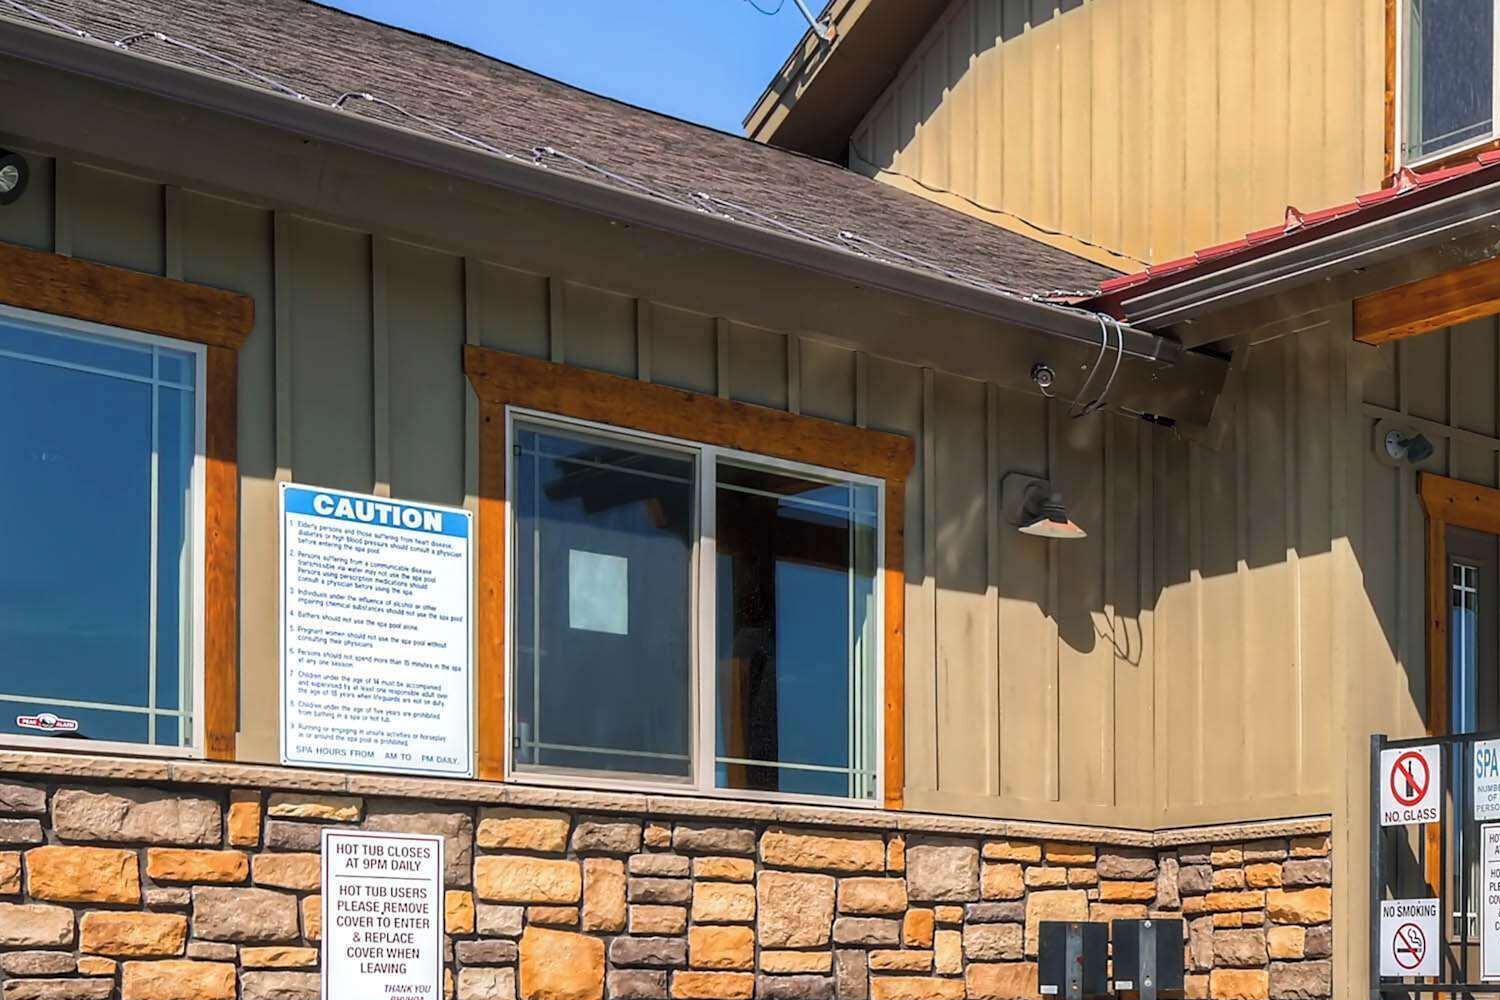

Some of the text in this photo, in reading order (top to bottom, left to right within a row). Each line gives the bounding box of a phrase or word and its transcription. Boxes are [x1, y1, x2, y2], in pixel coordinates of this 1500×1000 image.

[312, 493, 442, 532] CAUTION
[296, 744, 312, 753] SPA
[316, 746, 346, 756] HOURS
[350, 748, 374, 758] FROM
[384, 751, 397, 760] AM
[400, 753, 411, 761] TO
[421, 754, 433, 763] PM
[1476, 748, 1499, 779] SPA
[1488, 794, 1497, 802] OF
[1385, 808, 1437, 823] NO GLASS
[336, 844, 431, 858] HOT TUB CLOSES
[345, 858, 421, 872] AT 9PM DAILY
[339, 885, 427, 898] HOT TUB USERS
[337, 901, 429, 914] PLEASE REMOVE
[1383, 903, 1437, 918] NO SMOKING
[337, 916, 430, 929] COVER TO ENTER
[353, 932, 414, 944] & REPLACE
[347, 947, 420, 959] COVER WHEN
[360, 962, 407, 974] LEAVING
[384, 984, 432, 994] THANK YOU
